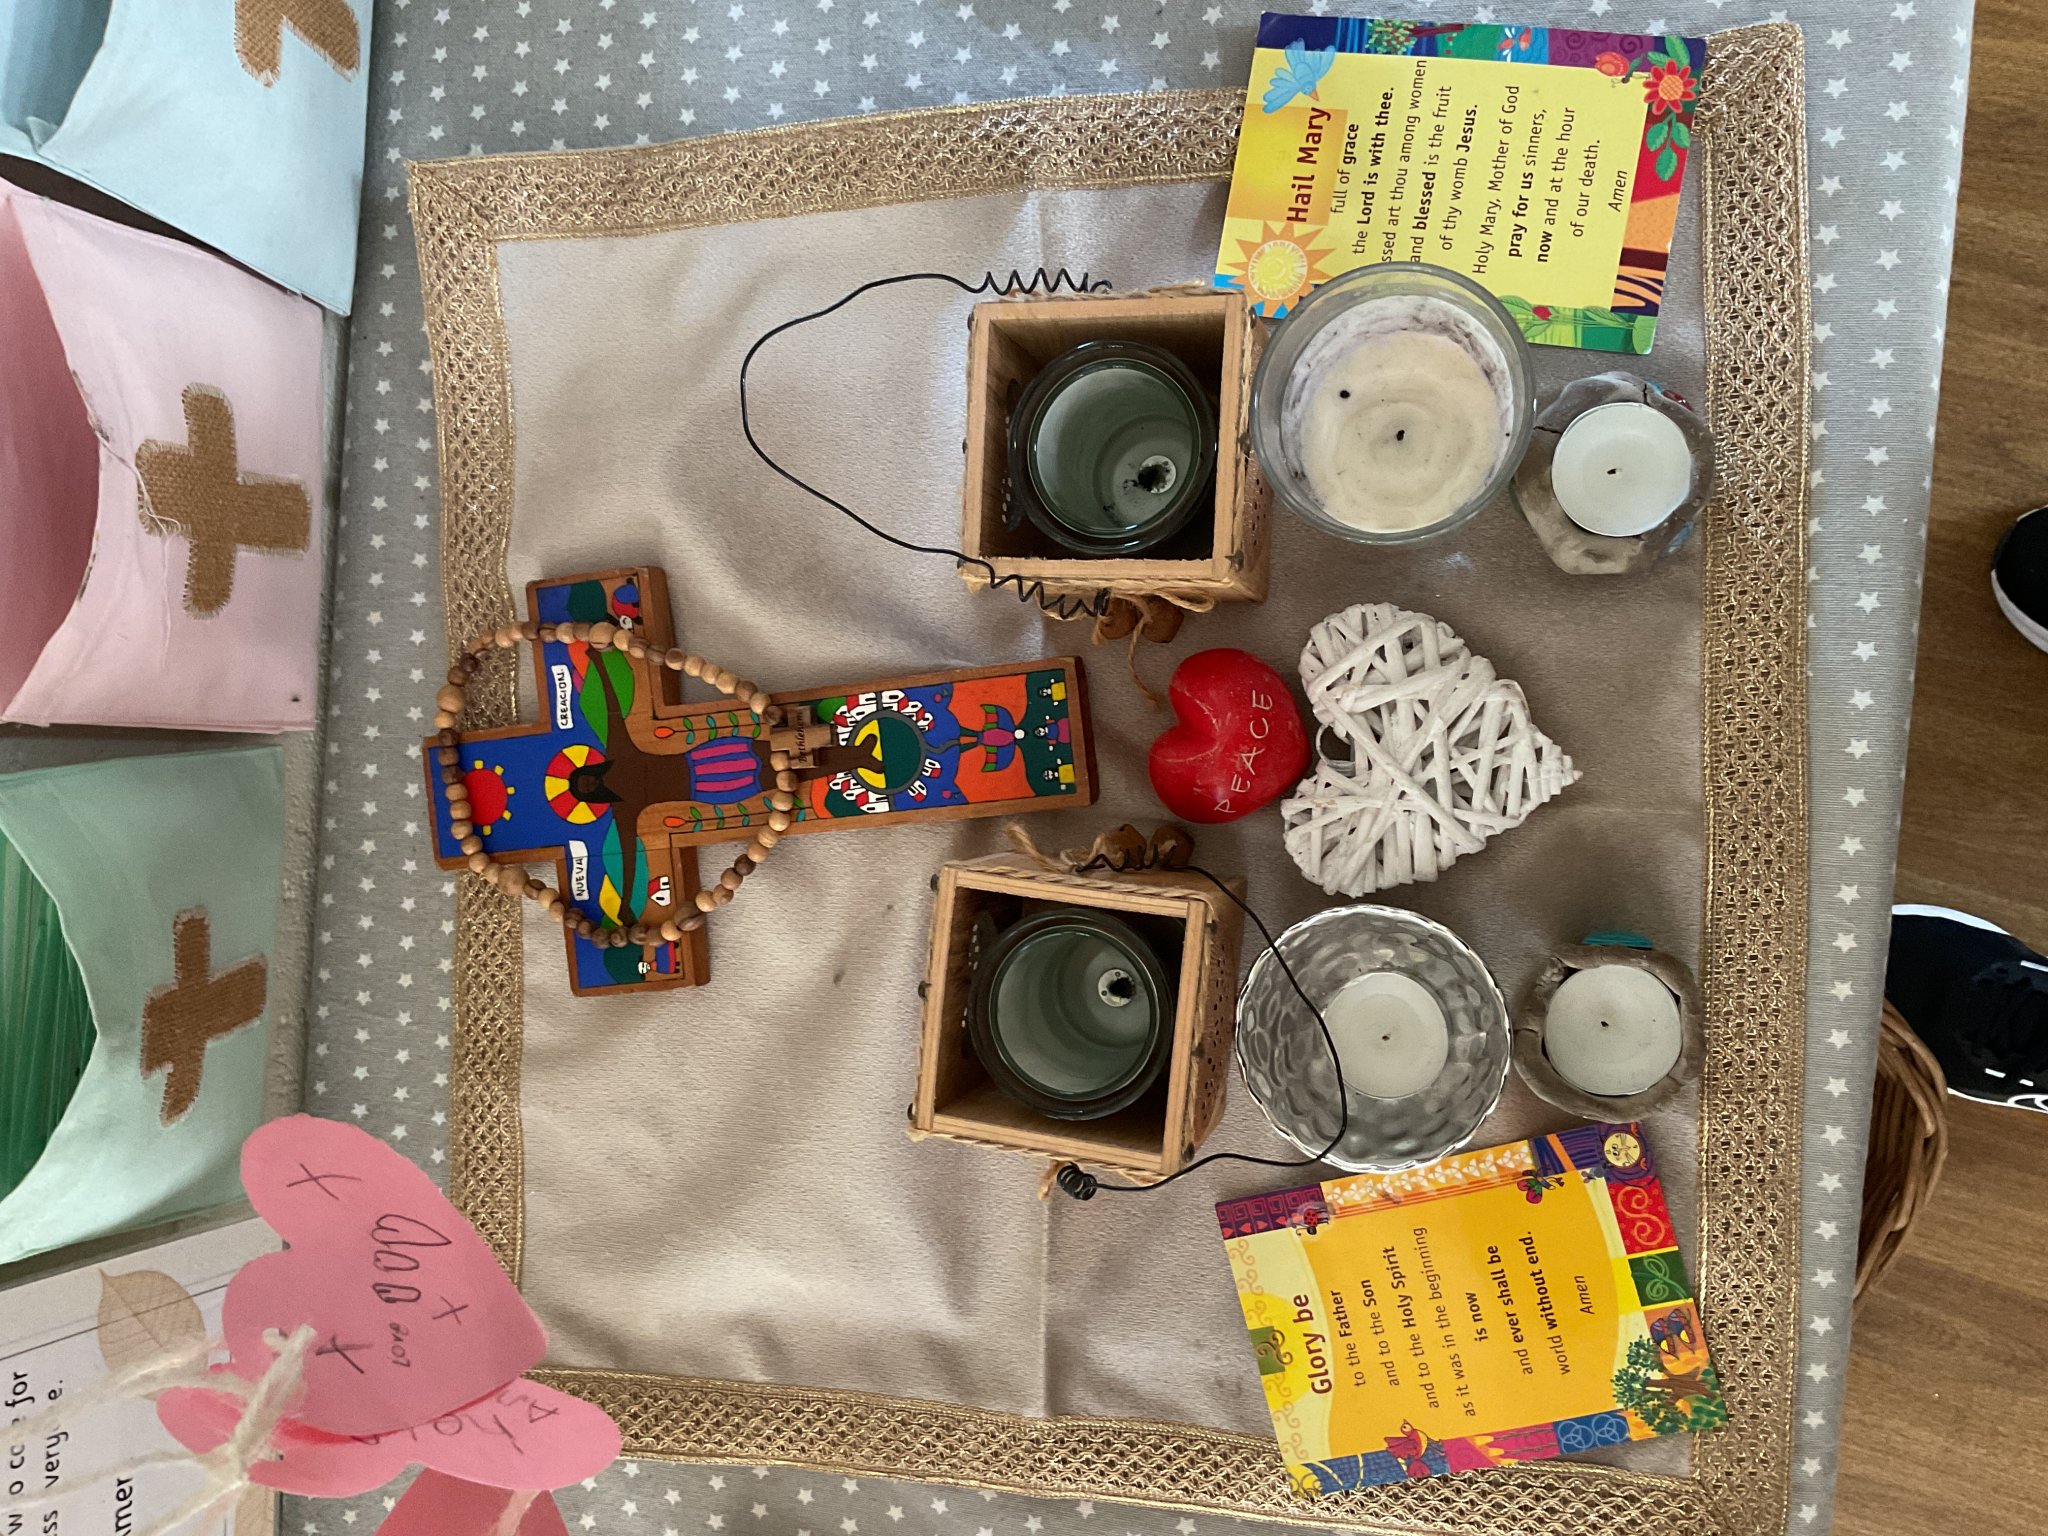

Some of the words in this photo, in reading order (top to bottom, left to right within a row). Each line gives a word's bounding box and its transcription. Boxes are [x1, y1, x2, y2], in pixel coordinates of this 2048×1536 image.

[1409, 60, 1427, 109] women
[1502, 86, 1519, 114] God
[1375, 87, 1394, 126] thee.
[1432, 85, 1452, 118] fruit
[1296, 107, 1331, 165] Mary
[1399, 115, 1420, 163] among
[1428, 125, 1444, 149] the
[1456, 104, 1478, 153] Jesus.
[1499, 118, 1513, 135] of
[1522, 108, 1547, 166] sinners,
[1555, 107, 1575, 141] hour
[1342, 123, 1359, 165] grace
[1369, 133, 1386, 167] with
[1423, 153, 1439, 166] is
[1551, 147, 1568, 172] the
[1337, 168, 1350, 184] of
[1488, 139, 1509, 192] Mother
[1578, 139, 1600, 187] death.
[1363, 172, 1379, 187] is
[1389, 168, 1408, 201] thou
[1450, 157, 1468, 201] womb
[1521, 172, 1534, 190] us
[1550, 177, 1563, 193] at
[1608, 170, 1628, 213] Amen
[1286, 174, 1315, 223] Hail
[1330, 189, 1348, 214] full
[1357, 191, 1375, 225] Lord
[1412, 171, 1436, 230] blessed
[1512, 195, 1529, 218] for
[1544, 198, 1559, 226] and
[1576, 192, 1590, 217] our
[1388, 205, 1401, 226] art
[1443, 206, 1462, 230] thy
[1480, 198, 1502, 236] Mary,
[1569, 221, 1585, 238] of
[1352, 230, 1368, 255] the
[1381, 231, 1396, 263] ssed
[1410, 236, 1425, 263] and
[1439, 234, 1453, 250] of
[1508, 224, 1528, 258] pray
[1537, 230, 1553, 262] now
[1472, 241, 1495, 274] Holy
[794, 710, 808, 764] Bethlehem
[1214, 689, 1273, 813] PEACE
[575, 856, 587, 898] NUEVA
[1487, 1245, 1501, 1264] be
[1518, 1231, 1539, 1264] end.
[1382, 1246, 1407, 1290] Spirit
[1413, 1227, 1443, 1300] beginning
[1360, 1279, 1377, 1307] Son
[1490, 1268, 1514, 1306] shall
[1529, 1269, 1558, 1330] without
[1574, 1275, 1595, 1315] Amen
[1292, 1294, 1314, 1323] be
[1330, 1290, 1352, 1338] Father
[1397, 1294, 1416, 1329] Holy
[1435, 1305, 1451, 1330] the
[1465, 1292, 1483, 1323] now
[1370, 1311, 1385, 1336] the
[1474, 1328, 1489, 1342] is
[1505, 1311, 1524, 1343] ever
[1345, 1342, 1361, 1367] the
[1378, 1340, 1391, 1356] to
[1409, 1333, 1425, 1357] the
[1443, 1334, 1456, 1349] in
[1547, 1335, 1571, 1375] world
[1303, 1332, 1333, 1394] Glory
[1380, 1360, 1400, 1386] and
[1418, 1362, 1431, 1378] to
[1449, 1353, 1465, 1379] was
[1513, 1348, 1533, 1375] and
[5, 1371, 35, 1408] for
[1354, 1371, 1366, 1387] to
[1456, 1384, 1469, 1397] it
[1420, 1382, 1440, 1408] and
[1463, 1401, 1476, 1417] as
